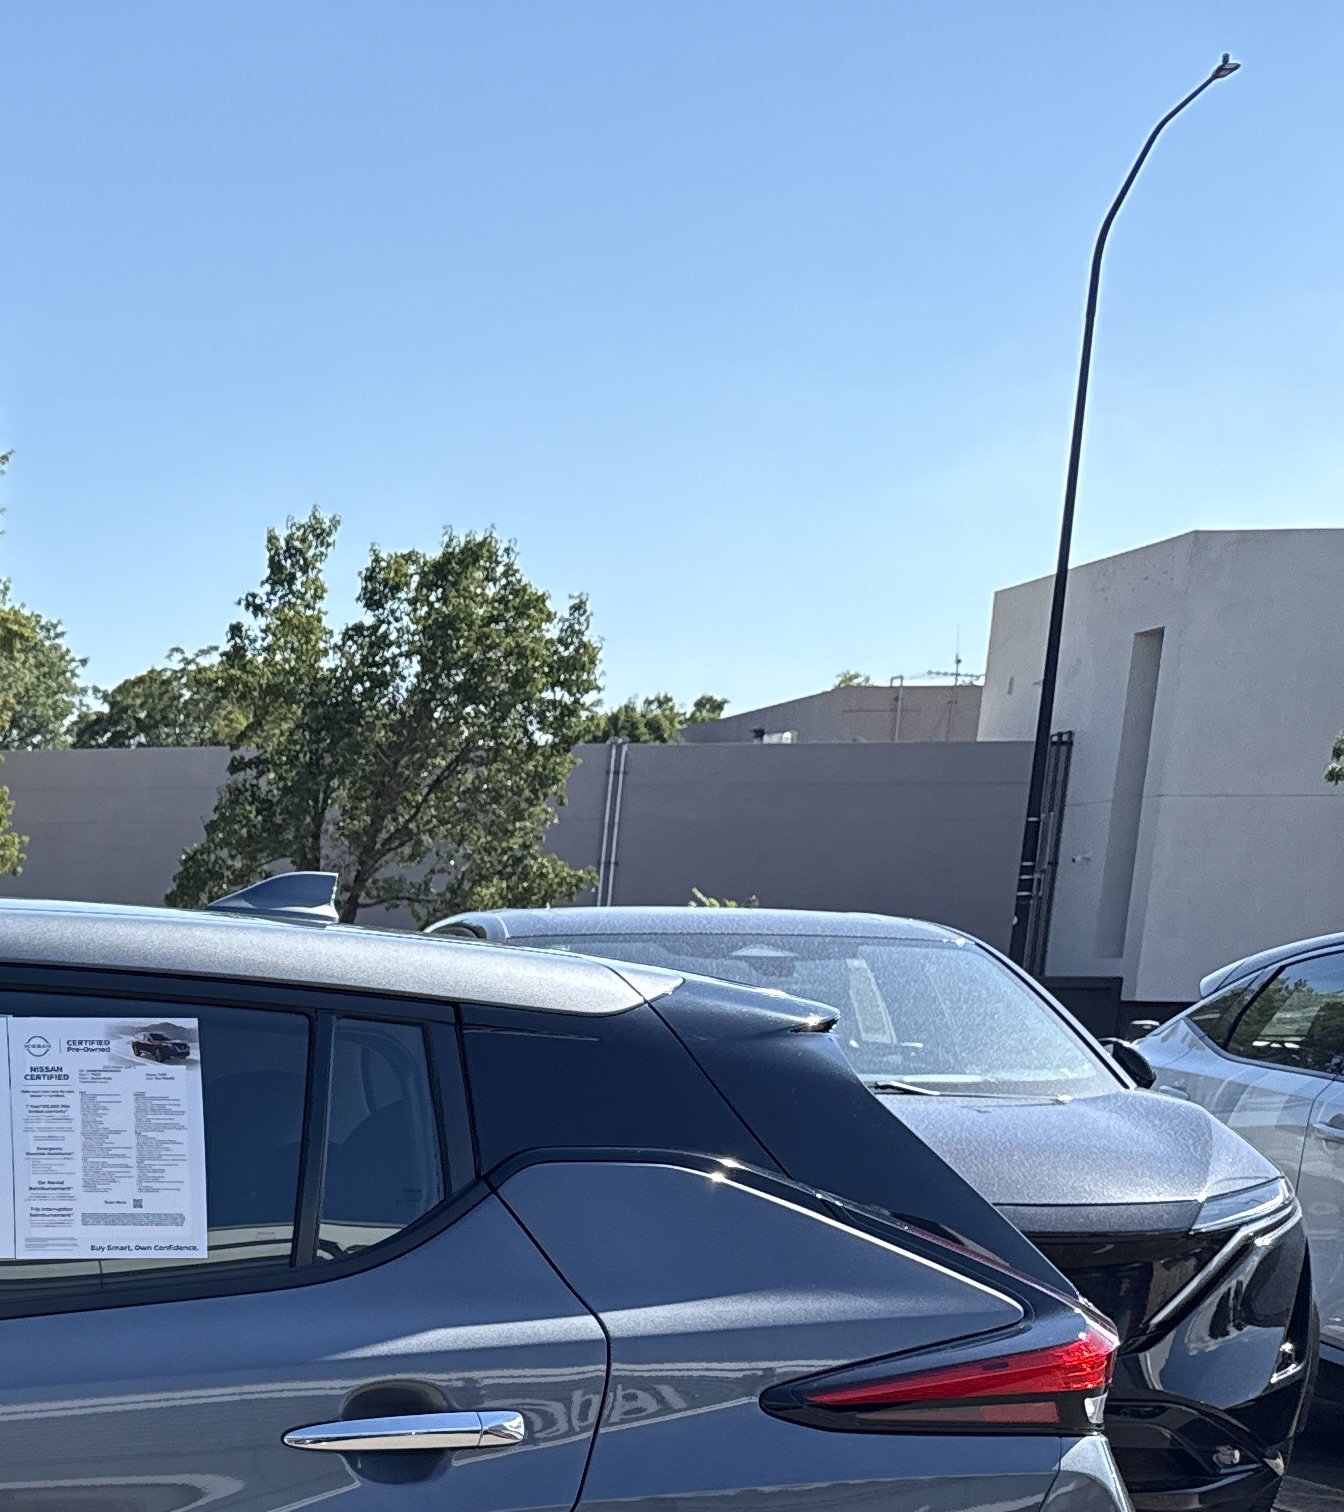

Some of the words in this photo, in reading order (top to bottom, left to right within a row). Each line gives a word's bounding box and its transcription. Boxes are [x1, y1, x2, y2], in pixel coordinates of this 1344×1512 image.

[29, 1065, 64, 1073] NISSAN
[23, 1073, 70, 1081] CERTIFIED
[90, 1244, 105, 1252] Buy
